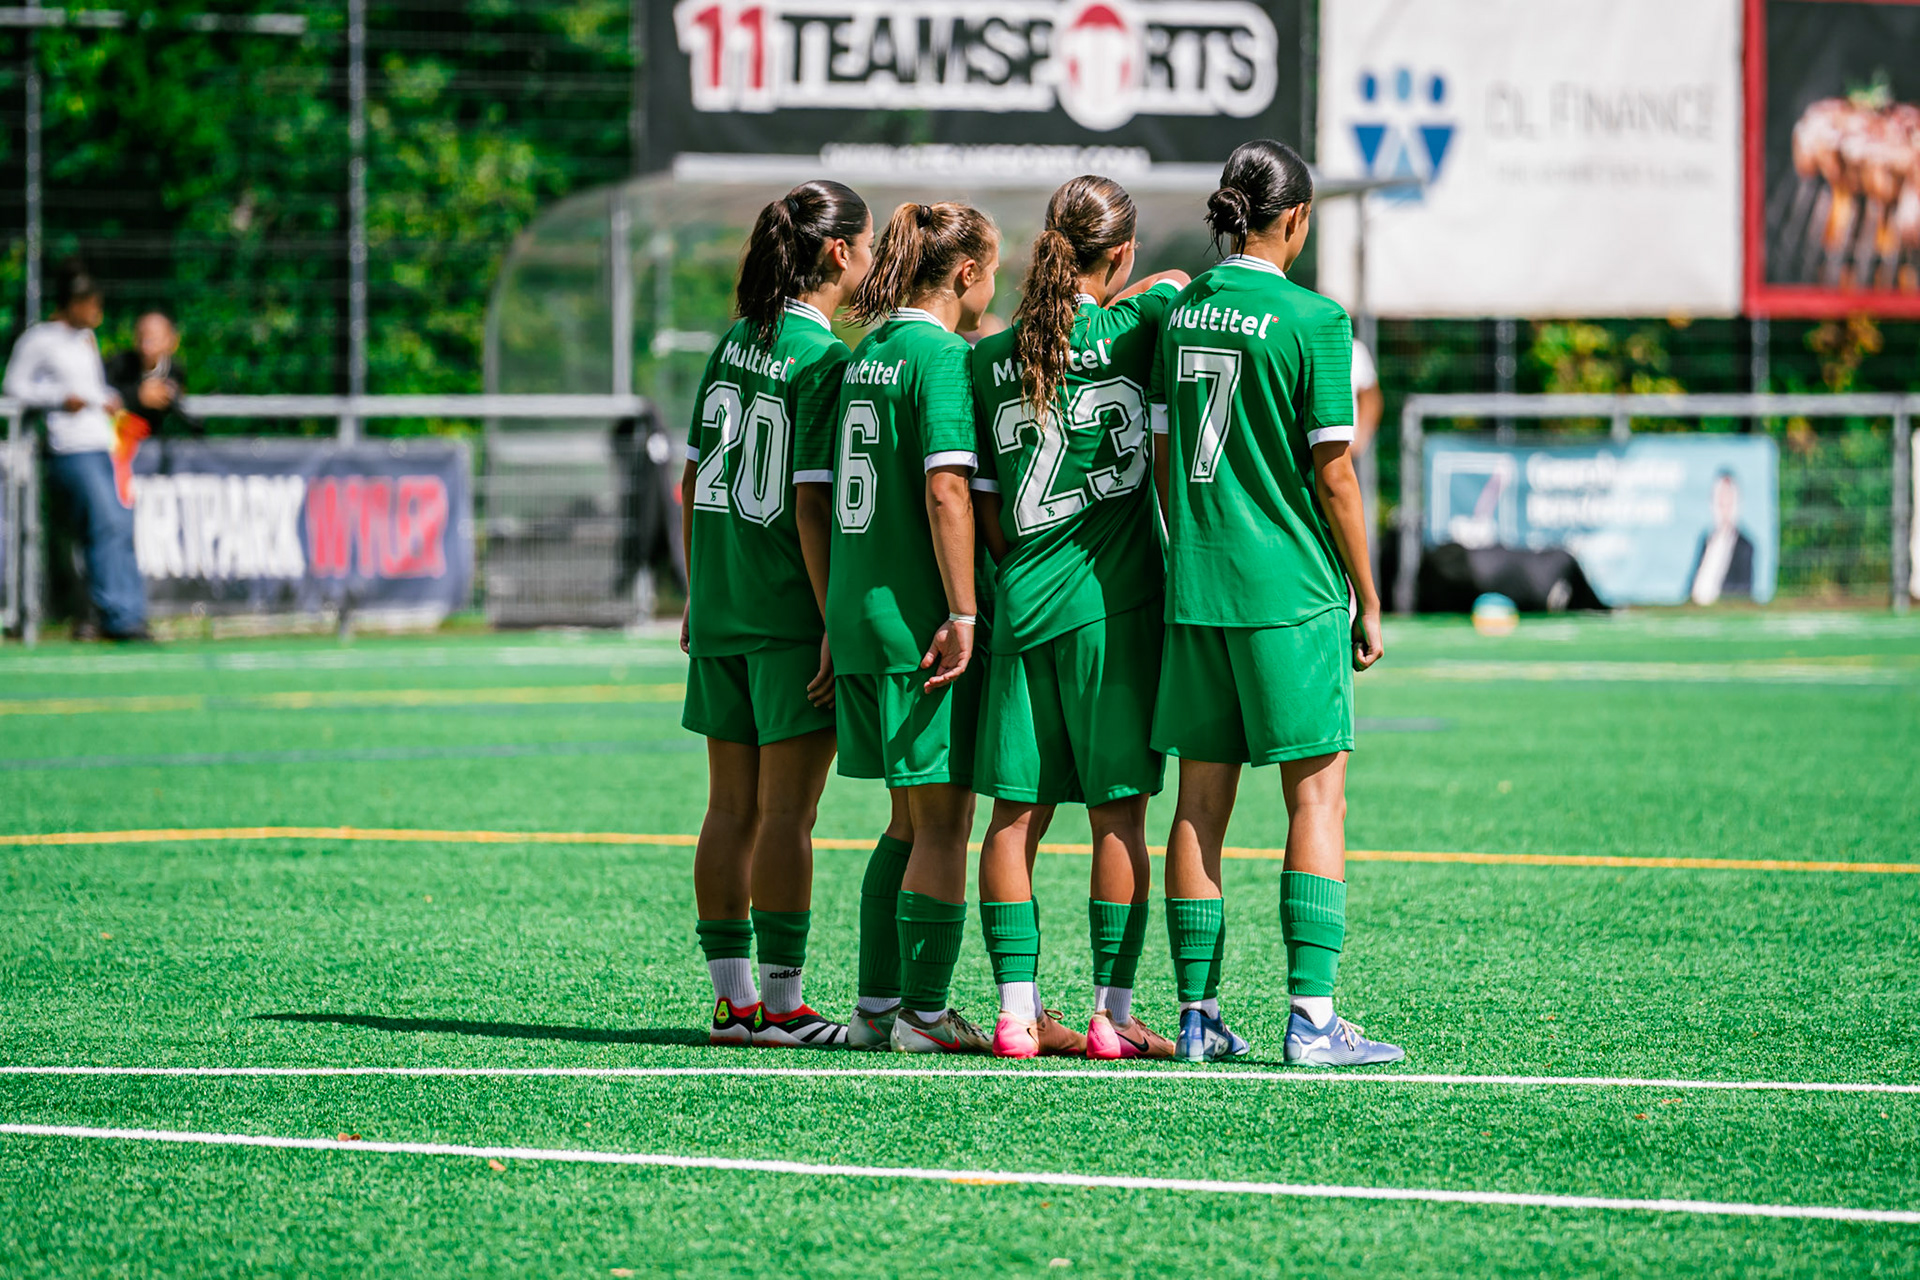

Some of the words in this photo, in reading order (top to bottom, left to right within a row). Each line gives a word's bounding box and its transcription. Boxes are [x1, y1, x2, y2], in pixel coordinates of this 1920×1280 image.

[720, 341, 791, 382] Multitel
[992, 338, 1112, 387] Mtel
[1167, 303, 1273, 340] Multitel
[693, 380, 791, 528] 20
[993, 375, 1149, 537] 23
[1177, 346, 1242, 483] 7
[836, 400, 880, 534] 6
[769, 968, 803, 979] adida
